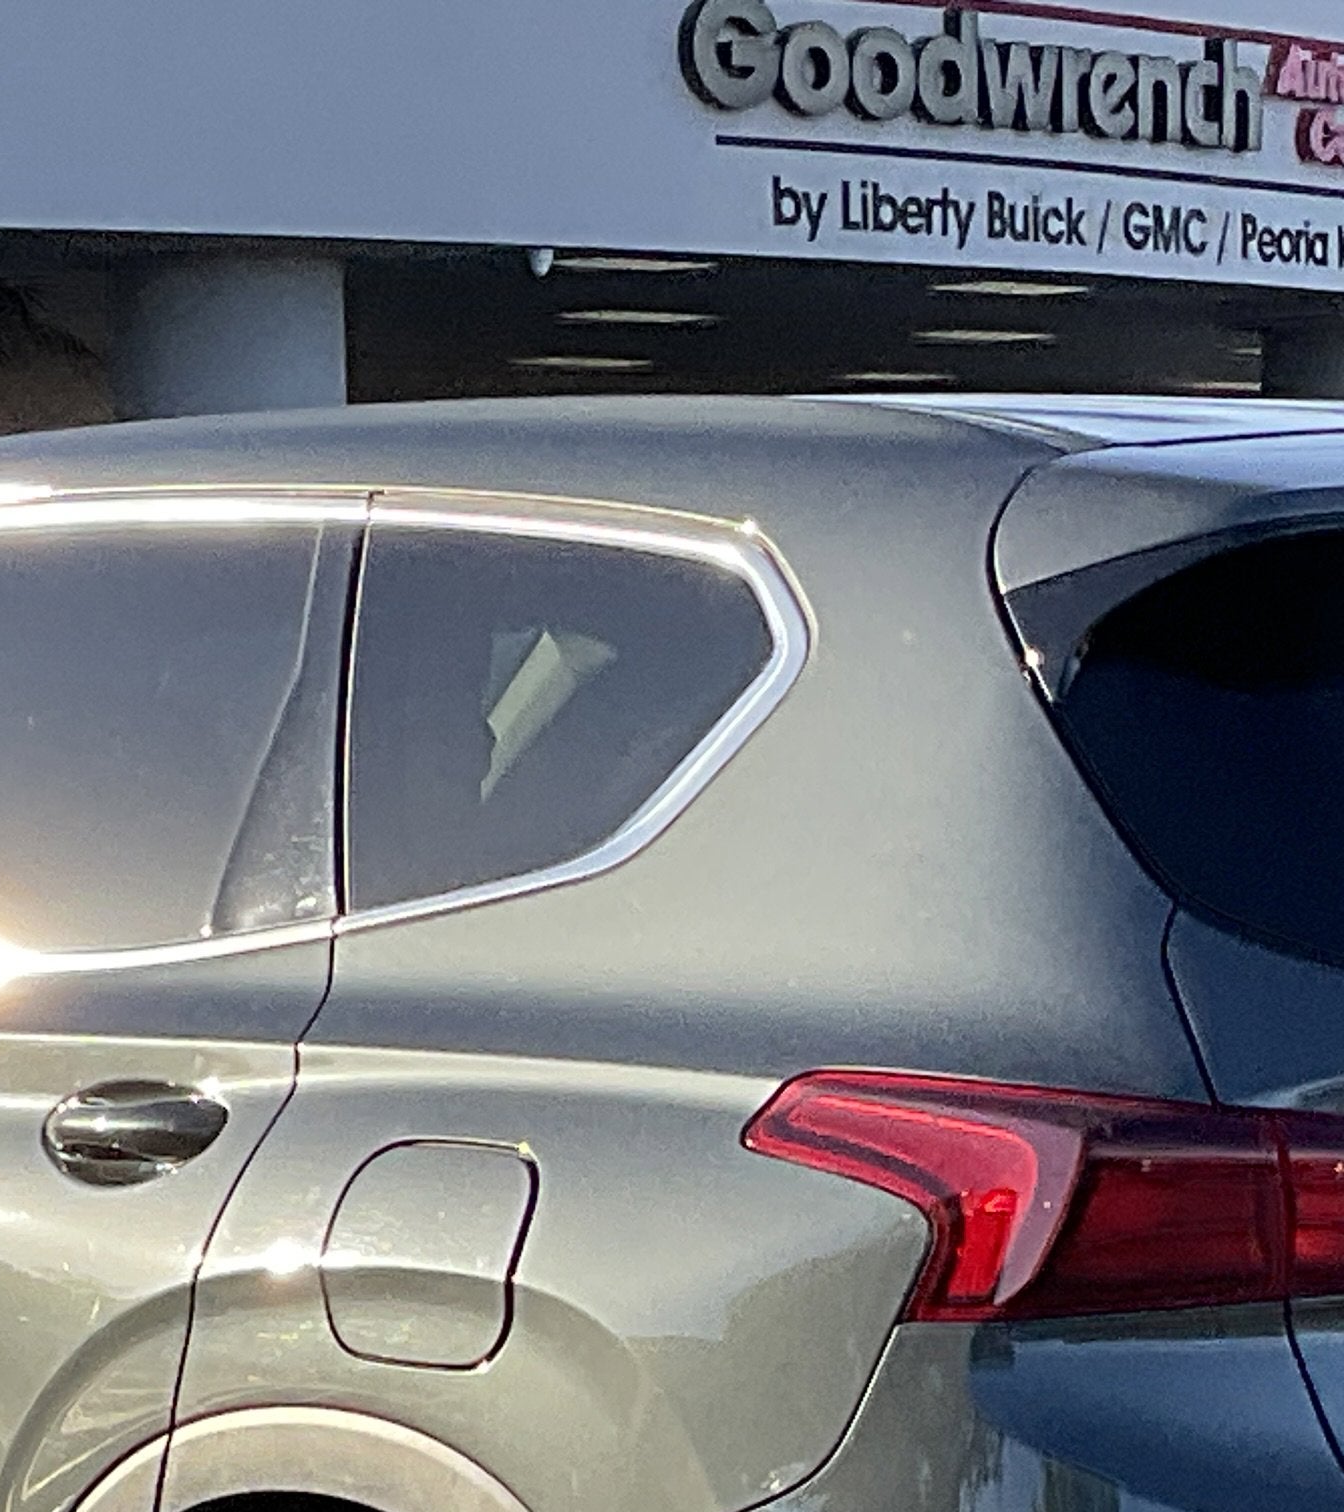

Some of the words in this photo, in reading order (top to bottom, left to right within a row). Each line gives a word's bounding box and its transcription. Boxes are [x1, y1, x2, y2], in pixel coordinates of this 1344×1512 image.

[678, 0, 1263, 153] Goodwrench
[772, 175, 828, 242] by
[841, 179, 977, 250] Liberty
[987, 190, 1087, 246] Buick
[1123, 202, 1207, 256] GMC
[1241, 212, 1329, 266] Peoria
